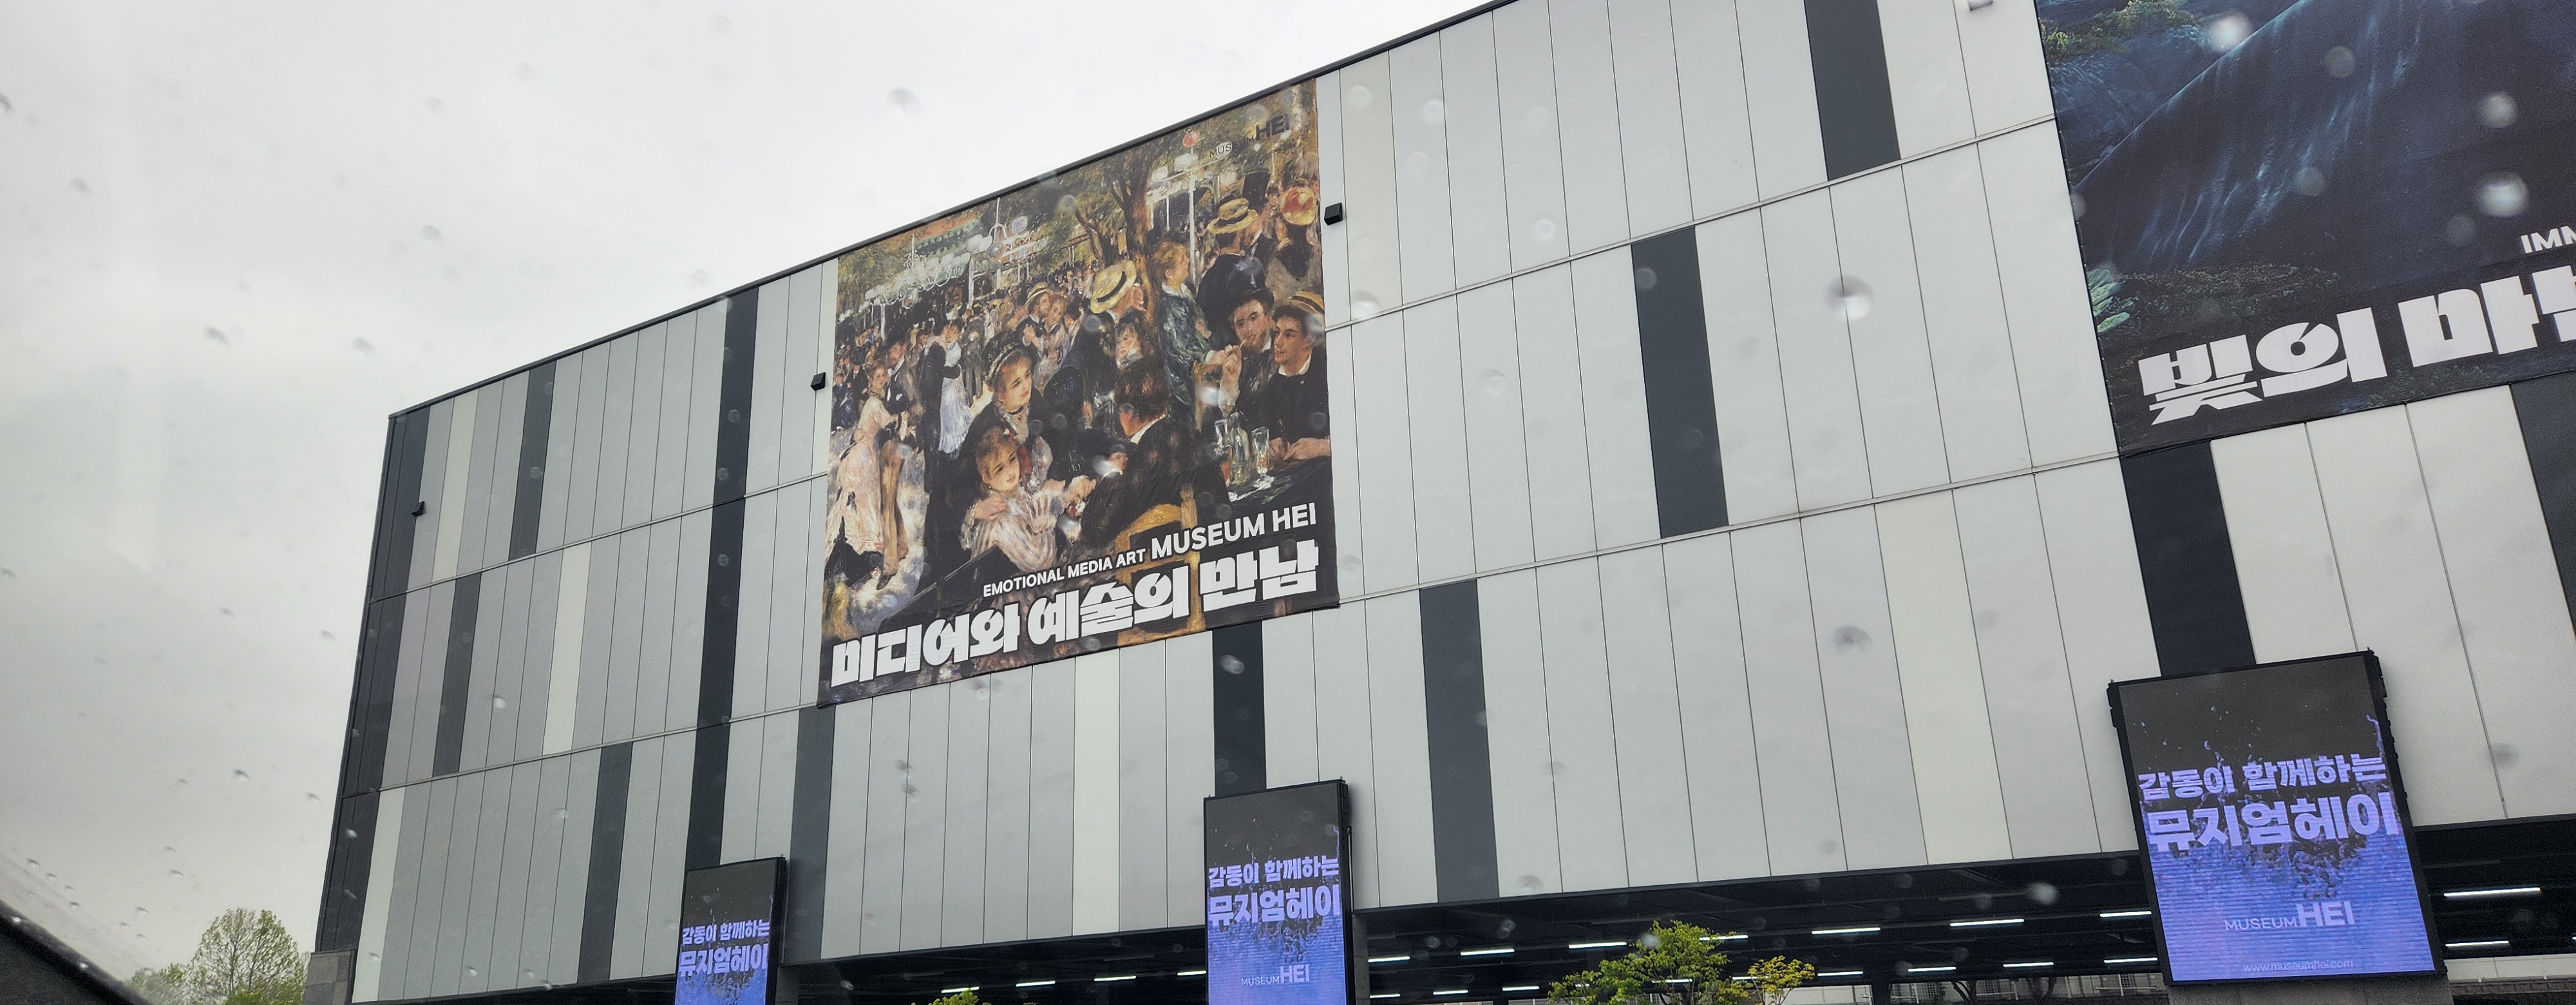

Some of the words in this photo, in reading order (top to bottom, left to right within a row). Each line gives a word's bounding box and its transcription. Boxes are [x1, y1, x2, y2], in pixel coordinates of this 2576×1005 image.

[2138, 307, 2387, 426] 빛의
[983, 570, 1065, 597] EMOTIONAL
[1067, 557, 1113, 579] MEDIA
[1116, 549, 1146, 565] ART
[1150, 513, 1265, 560] MUSEUM
[1271, 503, 1316, 531] HEI
[831, 602, 1019, 687] 미디어와
[1027, 567, 1190, 645] 예술의
[1198, 539, 1319, 611] 만남
[2138, 765, 2235, 799] 감동이
[2242, 753, 2387, 791] 함께하는
[2146, 792, 2399, 852] 뮤지엄헤이
[1209, 862, 1259, 888] 감동이
[1265, 855, 1339, 883] 함께하는
[1209, 884, 1341, 927] 뮤지엄헤이
[683, 924, 717, 944] 감동이
[720, 919, 770, 941] 함께하는
[679, 943, 768, 977] 뮤지엄헤이
